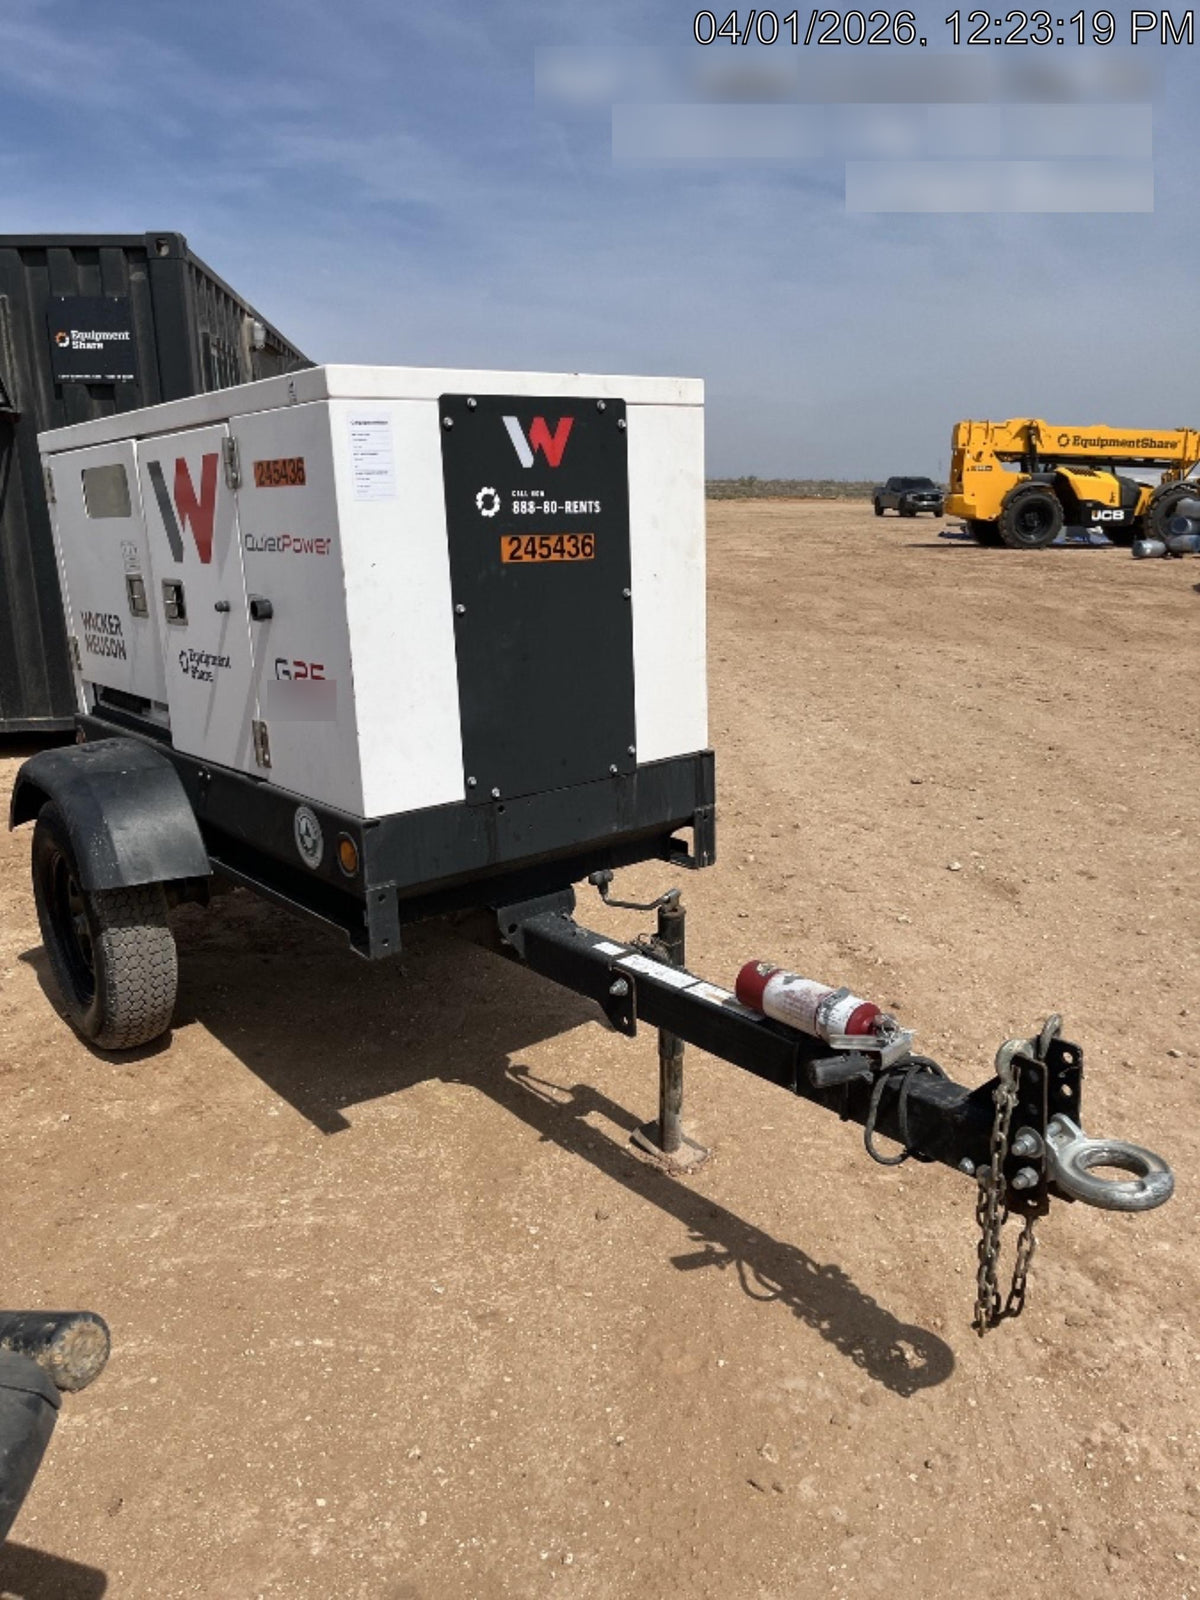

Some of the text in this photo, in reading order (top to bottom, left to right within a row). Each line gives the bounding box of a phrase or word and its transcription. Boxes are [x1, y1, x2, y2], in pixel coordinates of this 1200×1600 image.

[70, 330, 131, 342] Equipment
[71, 341, 104, 350] Share
[1071, 434, 1178, 450] EquipmentShare
[257, 457, 305, 486] 245436
[512, 500, 601, 515] 888-80-RENTS
[1091, 509, 1125, 522] JCB
[508, 535, 594, 561] 245436
[80, 610, 123, 637] WACKER
